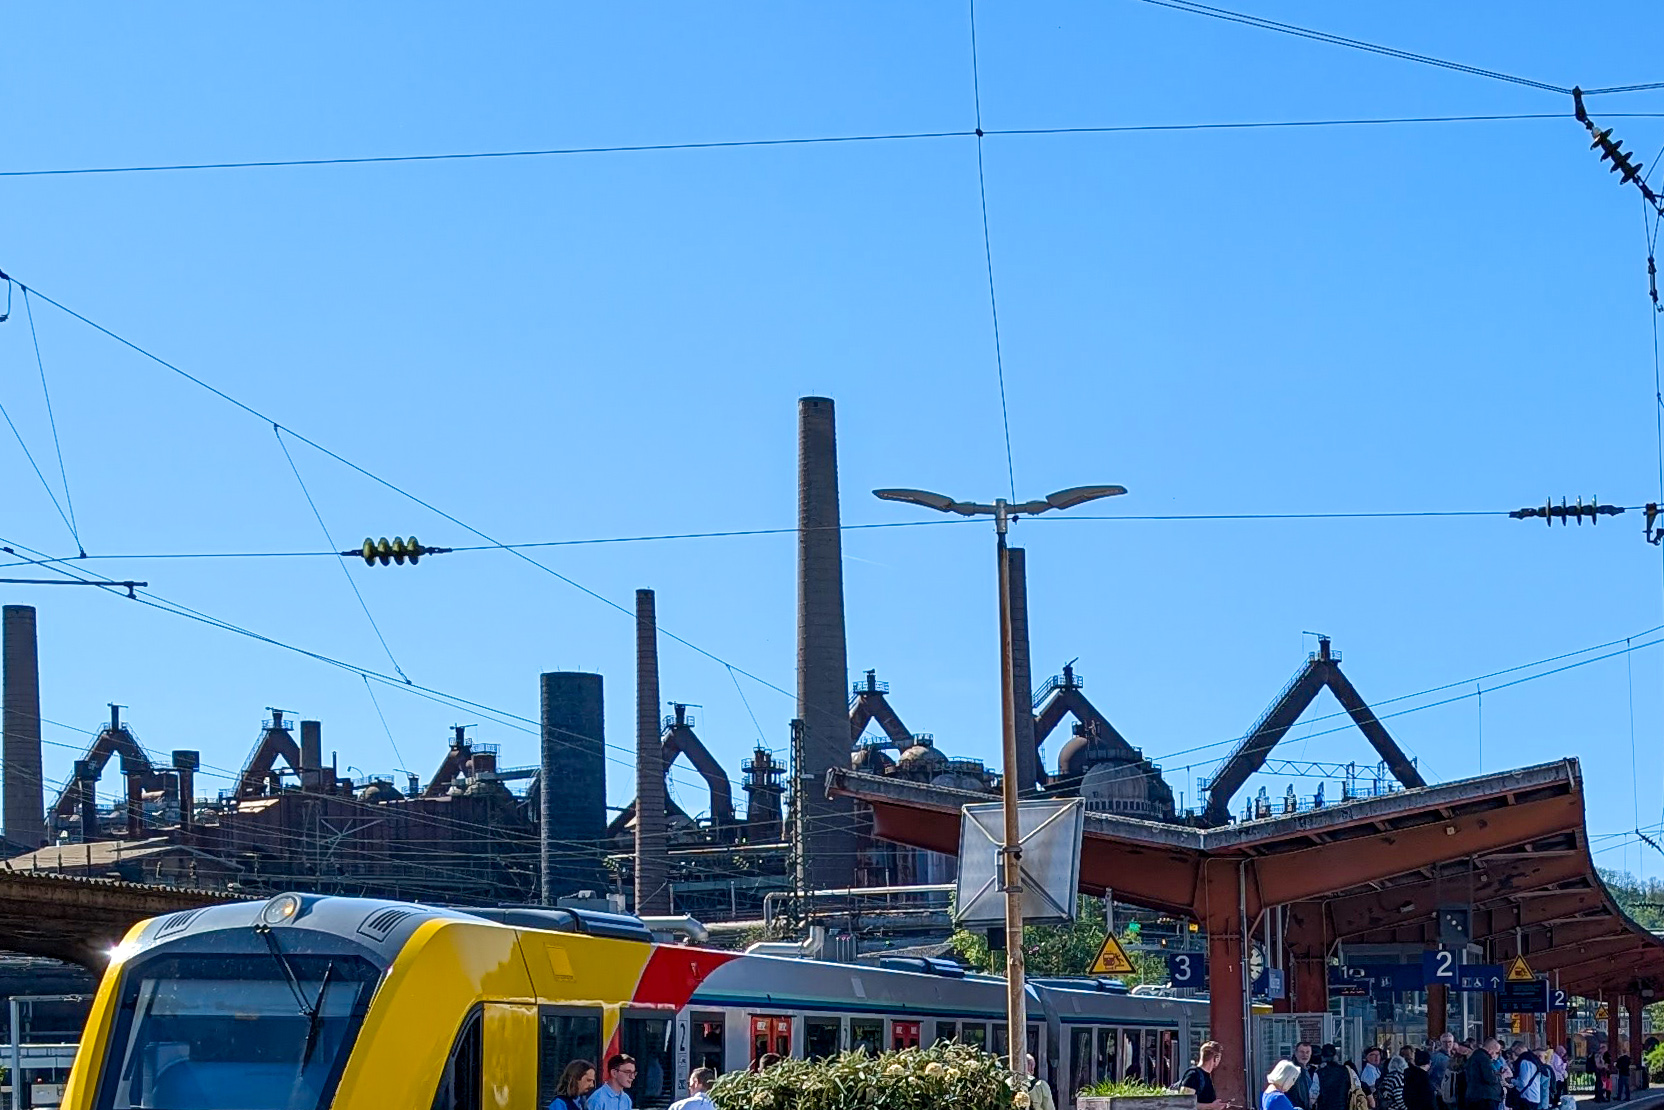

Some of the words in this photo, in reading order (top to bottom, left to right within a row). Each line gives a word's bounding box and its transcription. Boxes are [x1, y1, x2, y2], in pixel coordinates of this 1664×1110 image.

[1174, 954, 1192, 981] 3
[1341, 965, 1349, 978] 1
[1436, 951, 1453, 977] 2
[1554, 990, 1565, 1006] 2
[679, 1022, 686, 1051] 2
